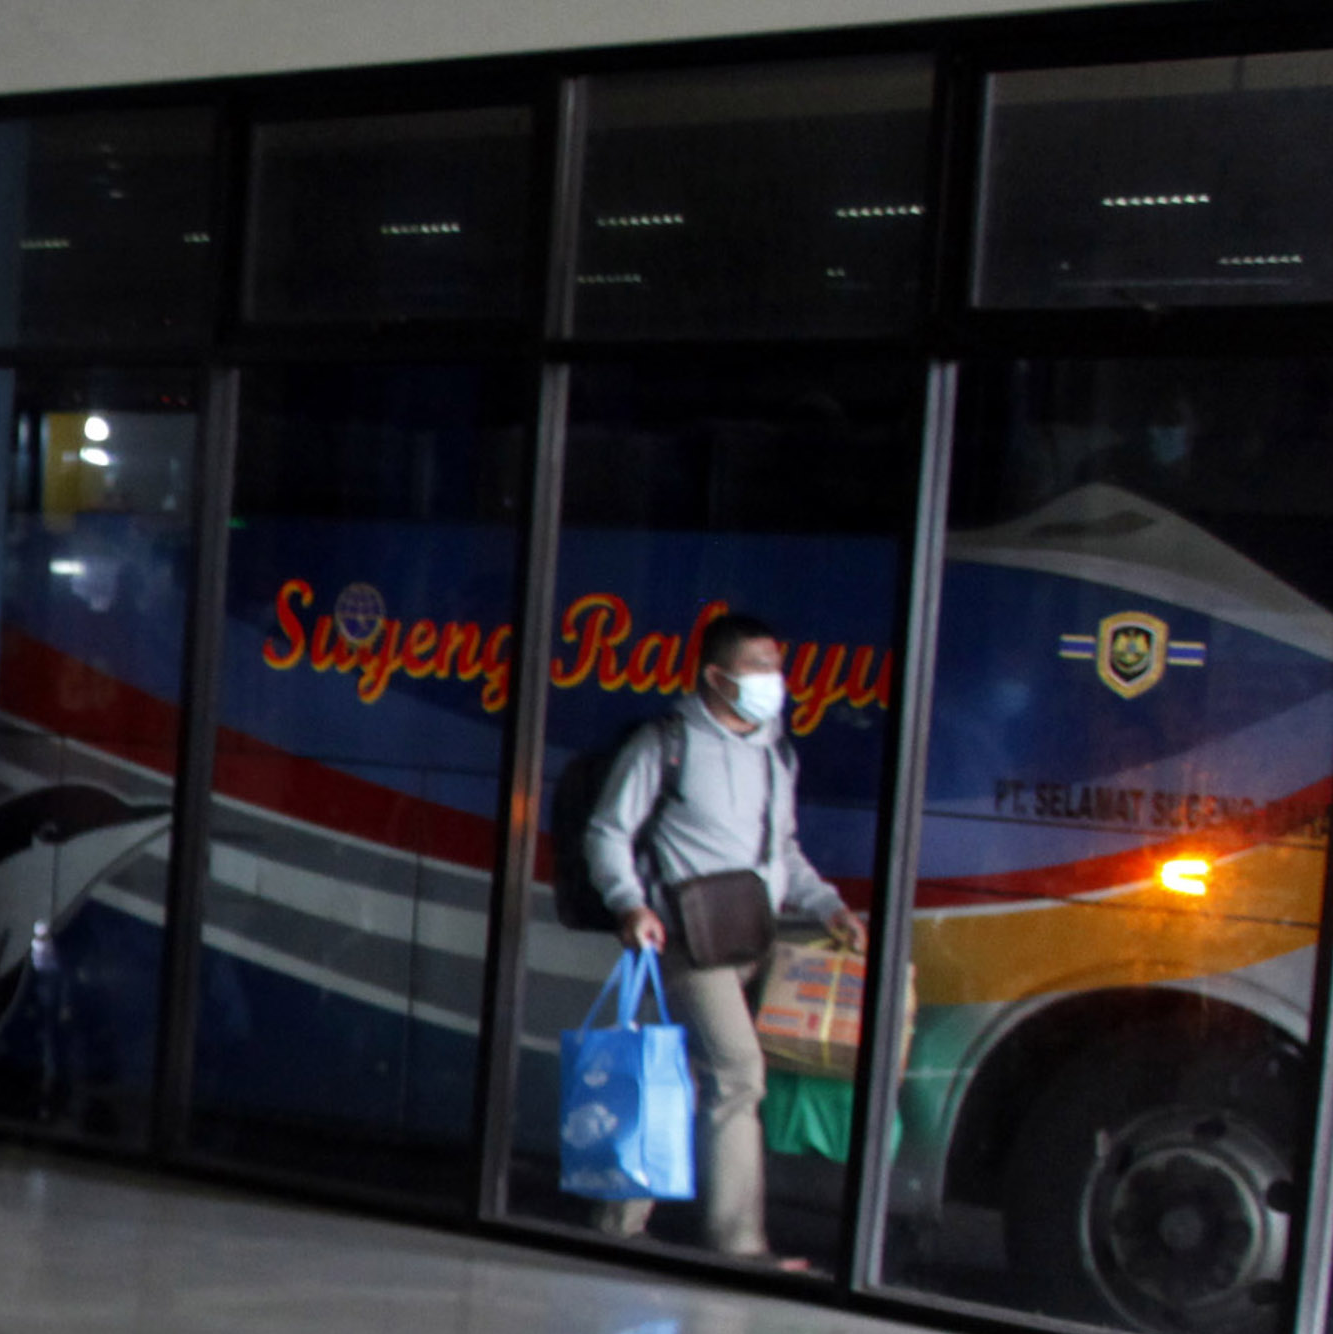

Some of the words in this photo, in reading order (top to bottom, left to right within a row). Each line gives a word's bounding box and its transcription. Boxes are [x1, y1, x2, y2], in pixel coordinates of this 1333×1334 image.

[262, 577, 515, 712] Sugeng
[549, 592, 896, 736] Rayu
[1034, 781, 1145, 822] SELAMAT
